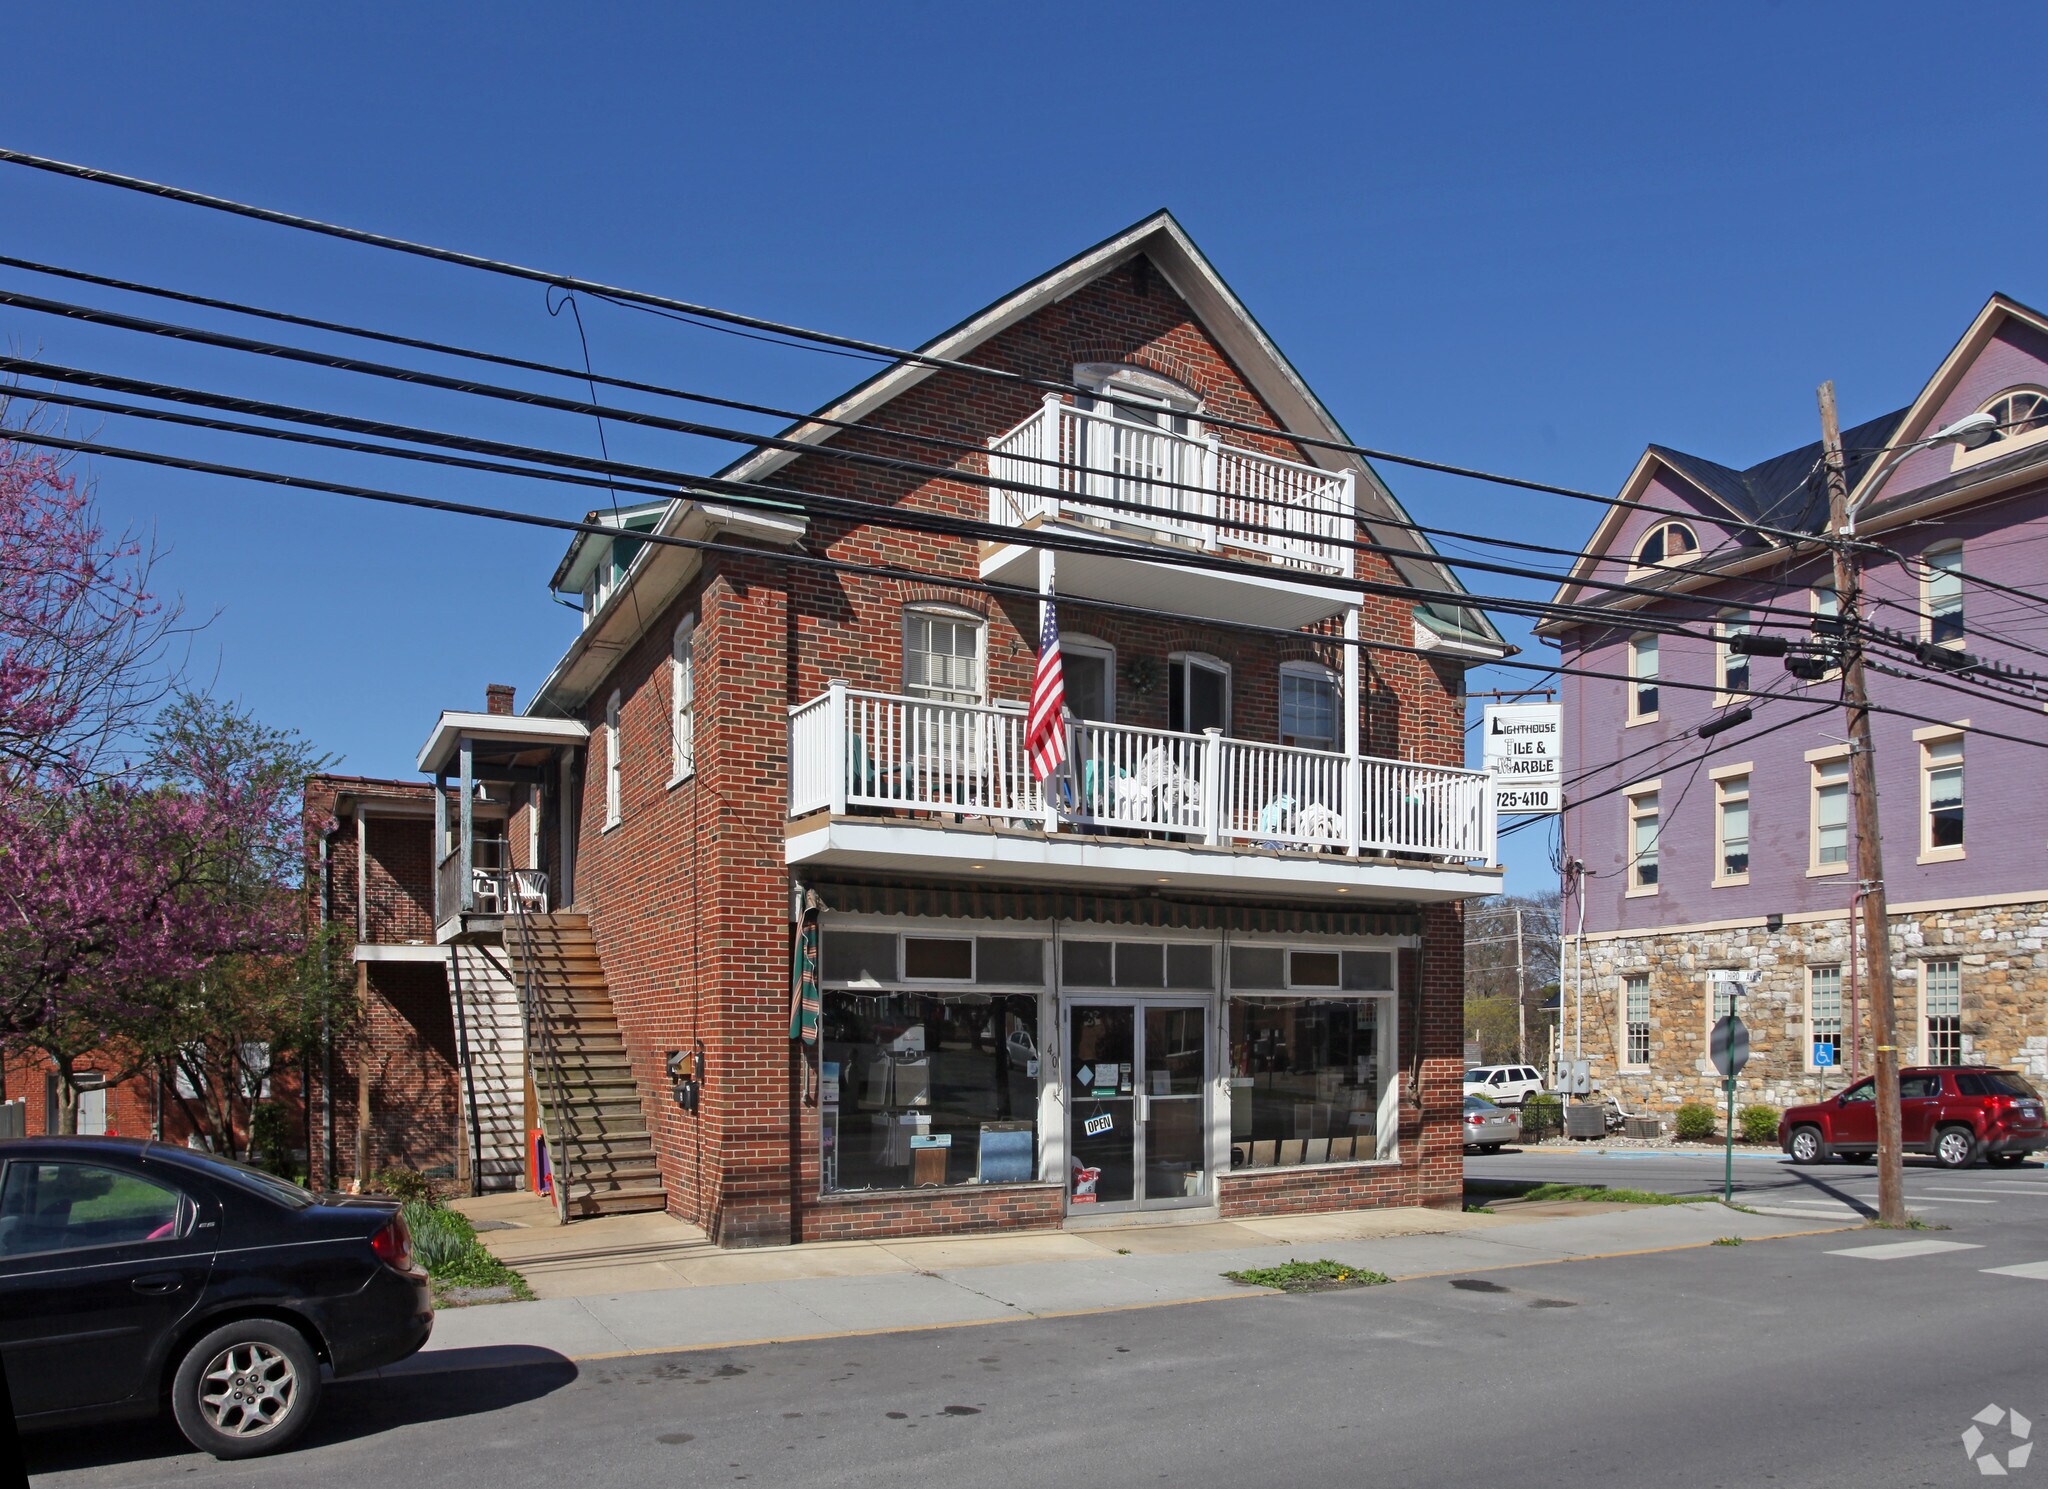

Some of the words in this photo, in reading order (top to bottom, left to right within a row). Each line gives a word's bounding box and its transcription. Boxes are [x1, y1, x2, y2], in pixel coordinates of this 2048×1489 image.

[1490, 716, 1557, 736] LIGHTHOUSE
[1504, 738, 1533, 756] TILE
[1536, 741, 1546, 755] &
[1497, 757, 1554, 774] MARBLE
[1497, 791, 1548, 807] 725-4110
[1087, 1115, 1112, 1133] OPEN
